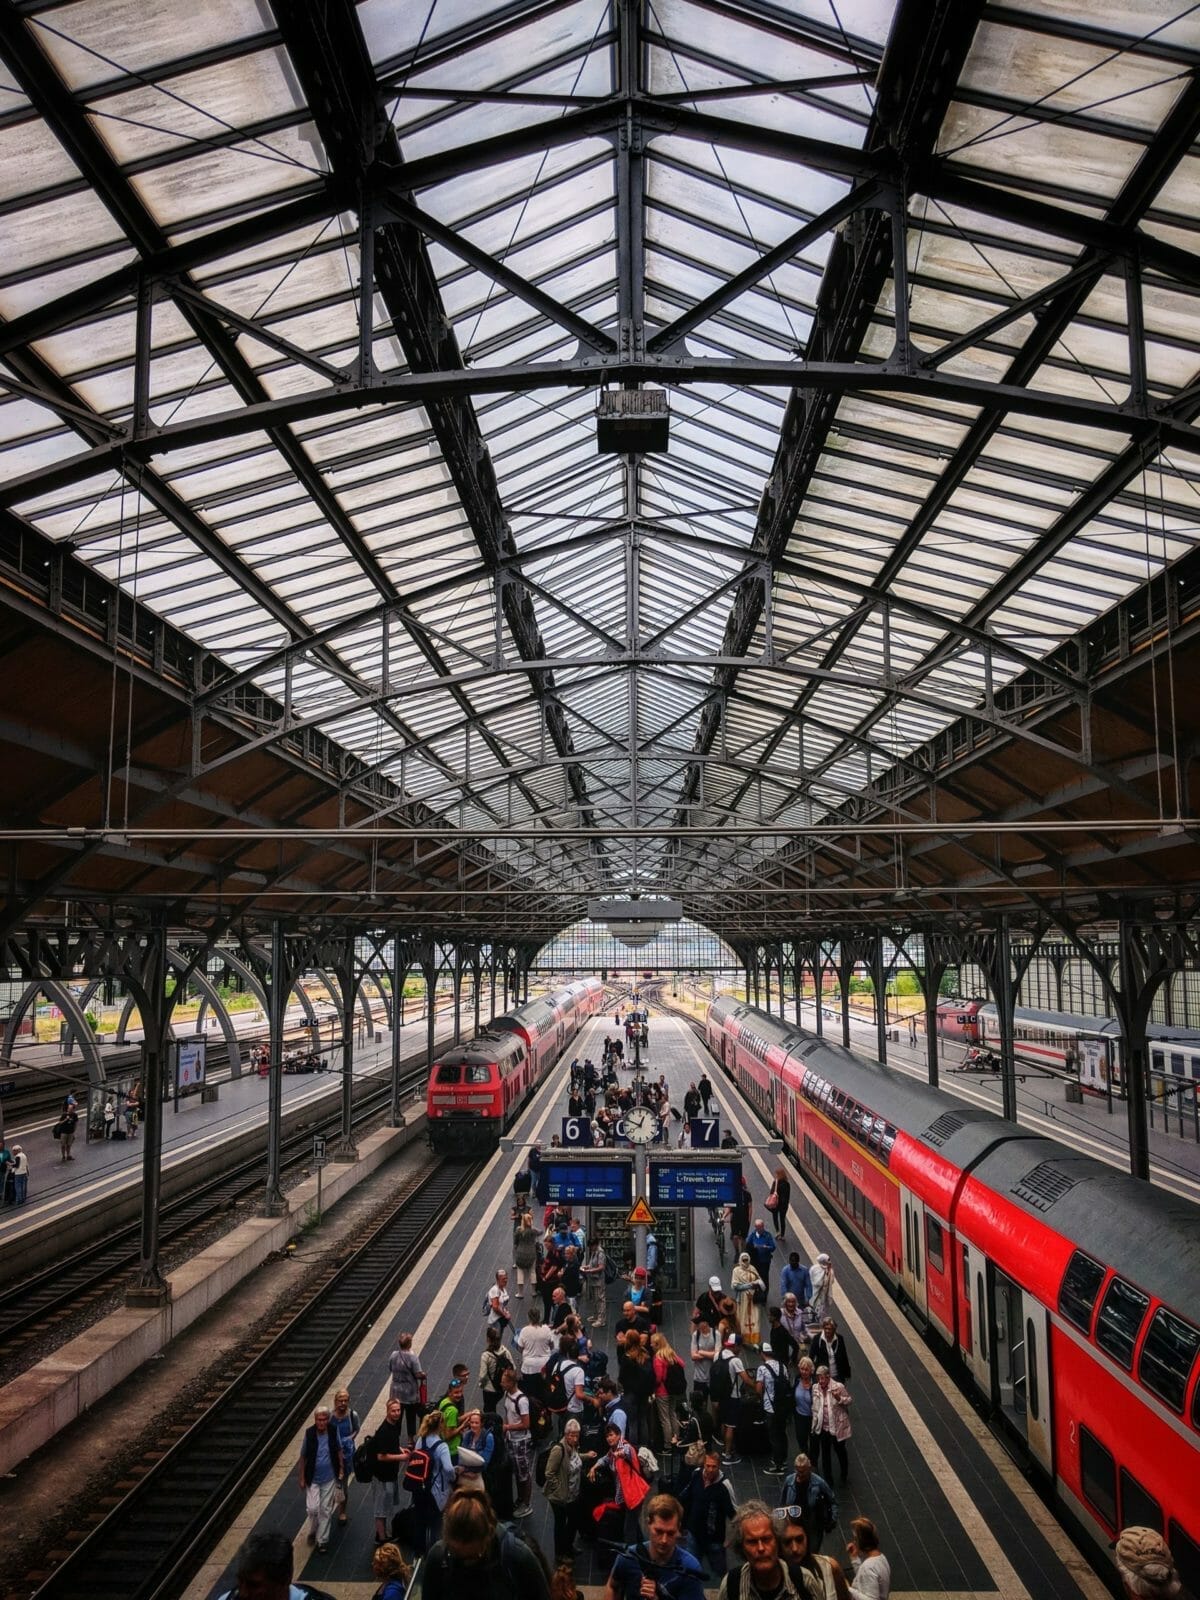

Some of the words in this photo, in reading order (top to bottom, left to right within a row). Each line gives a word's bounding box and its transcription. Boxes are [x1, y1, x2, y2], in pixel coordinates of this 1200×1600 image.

[565, 1118, 580, 1140] 6
[701, 1119, 716, 1141] 7
[315, 1142, 324, 1157] H
[706, 1175, 725, 1183] Strand
[1069, 1420, 1076, 1444] 2
